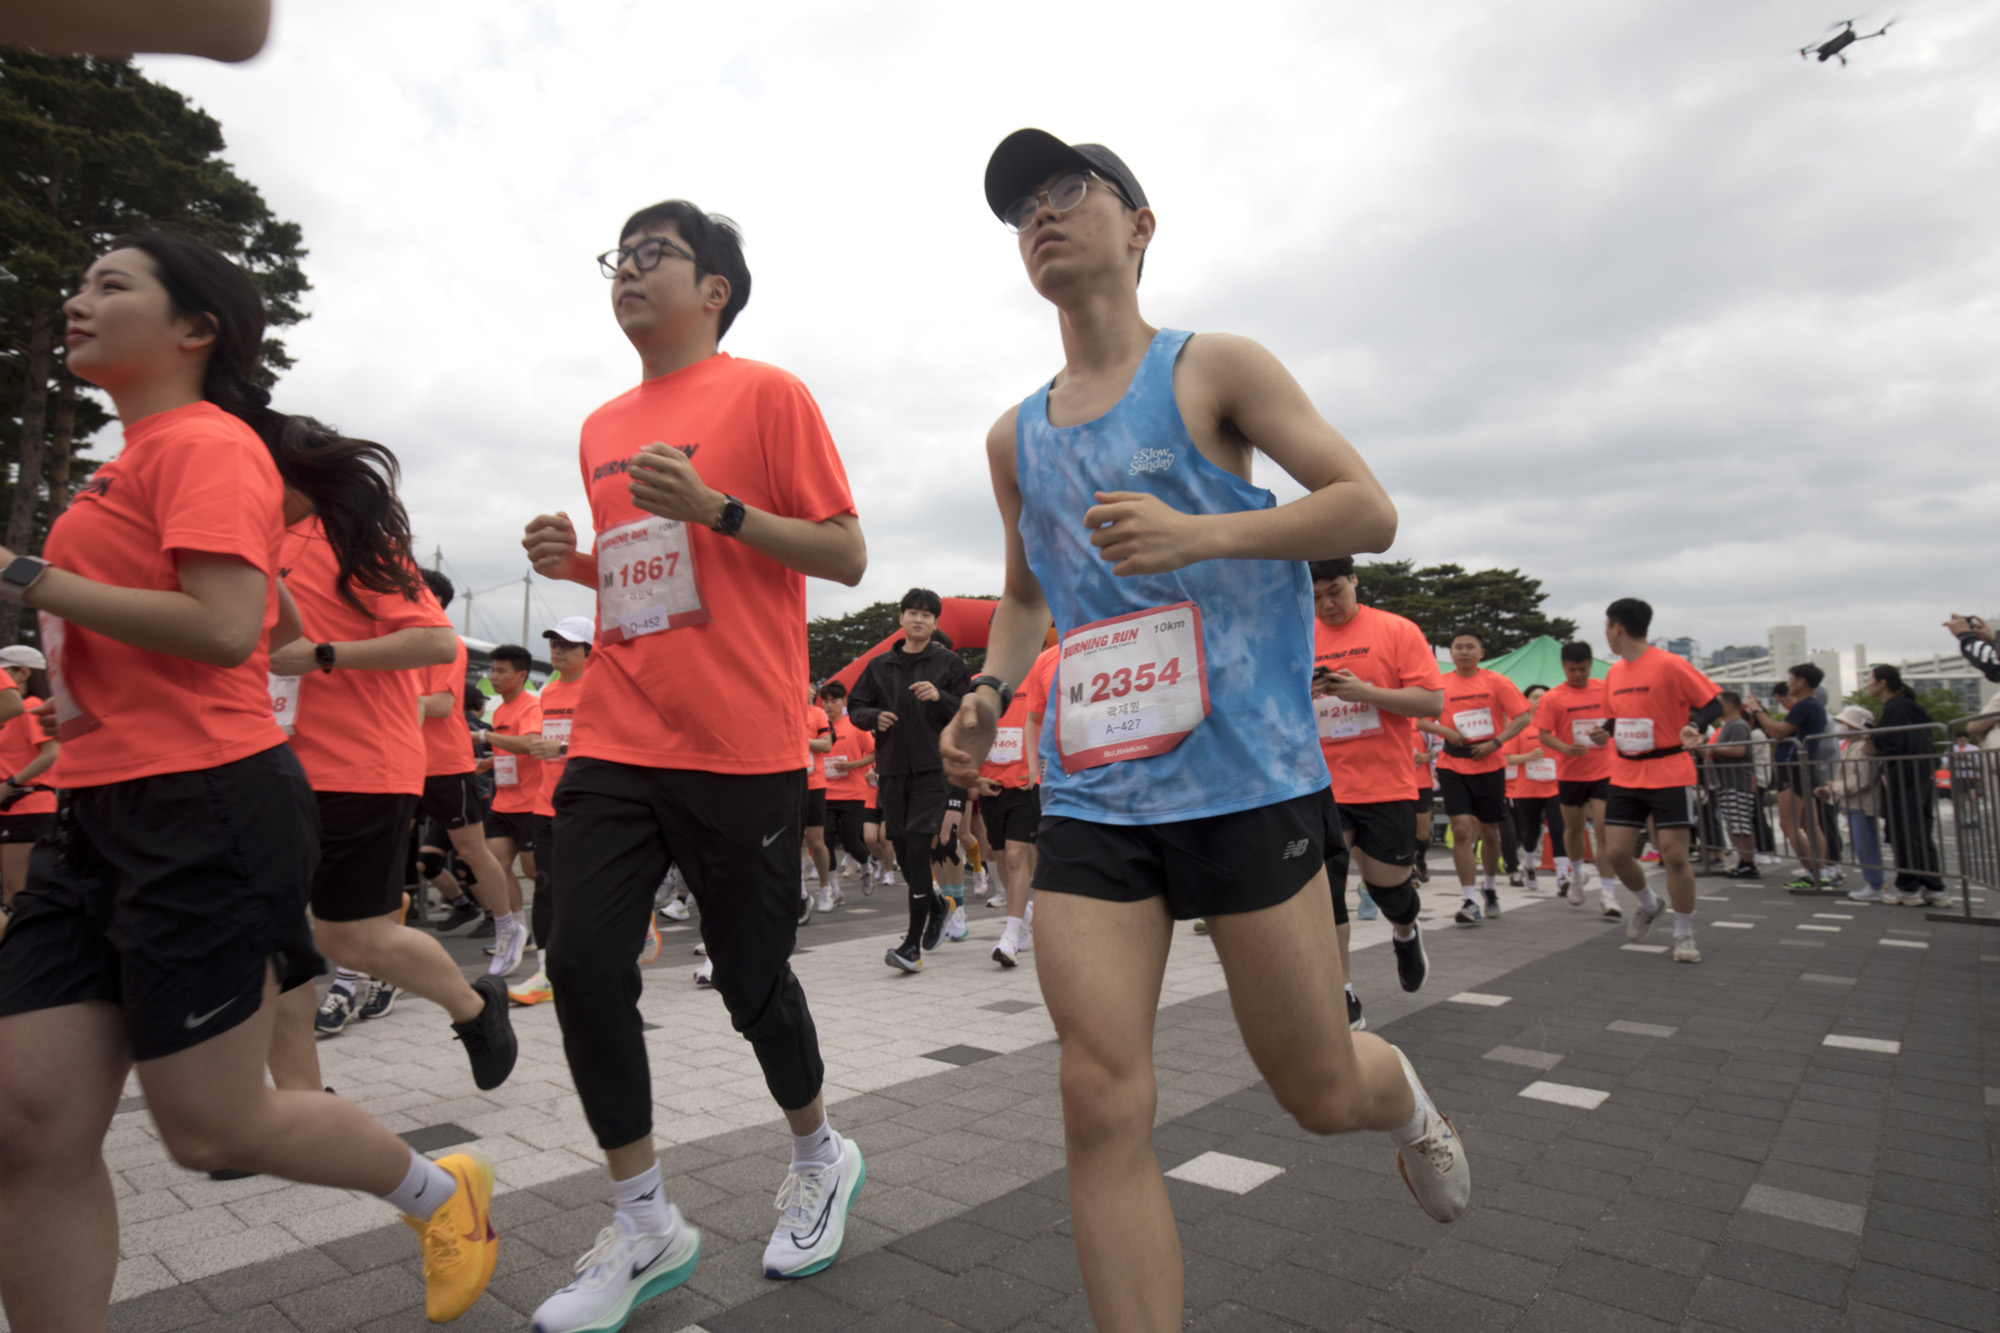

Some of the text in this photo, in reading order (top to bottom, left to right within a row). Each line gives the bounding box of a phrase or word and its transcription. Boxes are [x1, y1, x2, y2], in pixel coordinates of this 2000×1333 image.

[1128, 453, 1175, 476] Sunday
[1133, 448, 1170, 463] Slow
[604, 551, 680, 589] M 1867
[1153, 620, 1185, 634] 10km
[1063, 627, 1140, 660] BURNING RUN
[1070, 657, 1181, 704] M 2354
[1331, 701, 1369, 718] 2148
[1105, 718, 1142, 735] A-427
